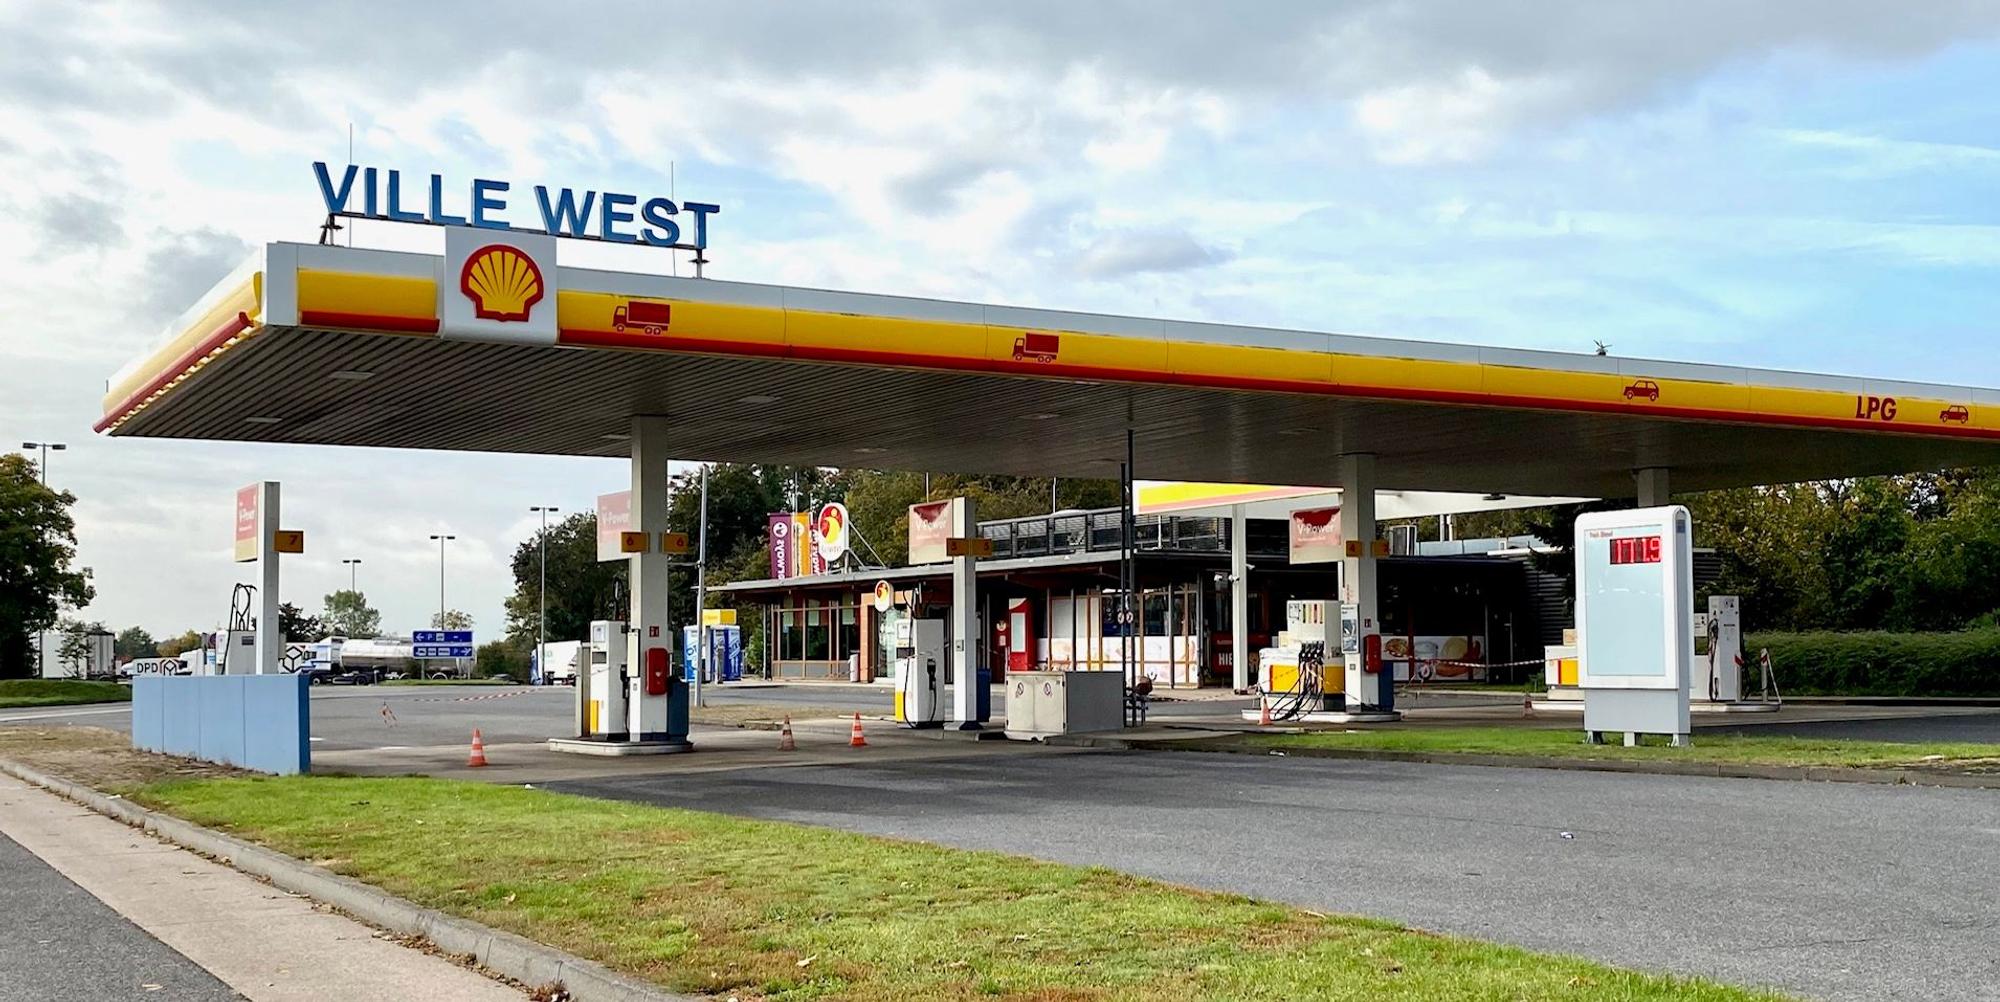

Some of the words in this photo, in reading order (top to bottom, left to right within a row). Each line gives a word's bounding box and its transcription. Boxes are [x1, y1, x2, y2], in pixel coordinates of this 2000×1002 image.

[312, 161, 511, 229] VILLE
[534, 185, 720, 249] WEST
[1855, 395, 1897, 422] LPG
[1297, 522, 1335, 535] V-Power
[289, 534, 298, 545] 7
[1218, 652, 1233, 666] HIE
[137, 662, 158, 674] DPD
